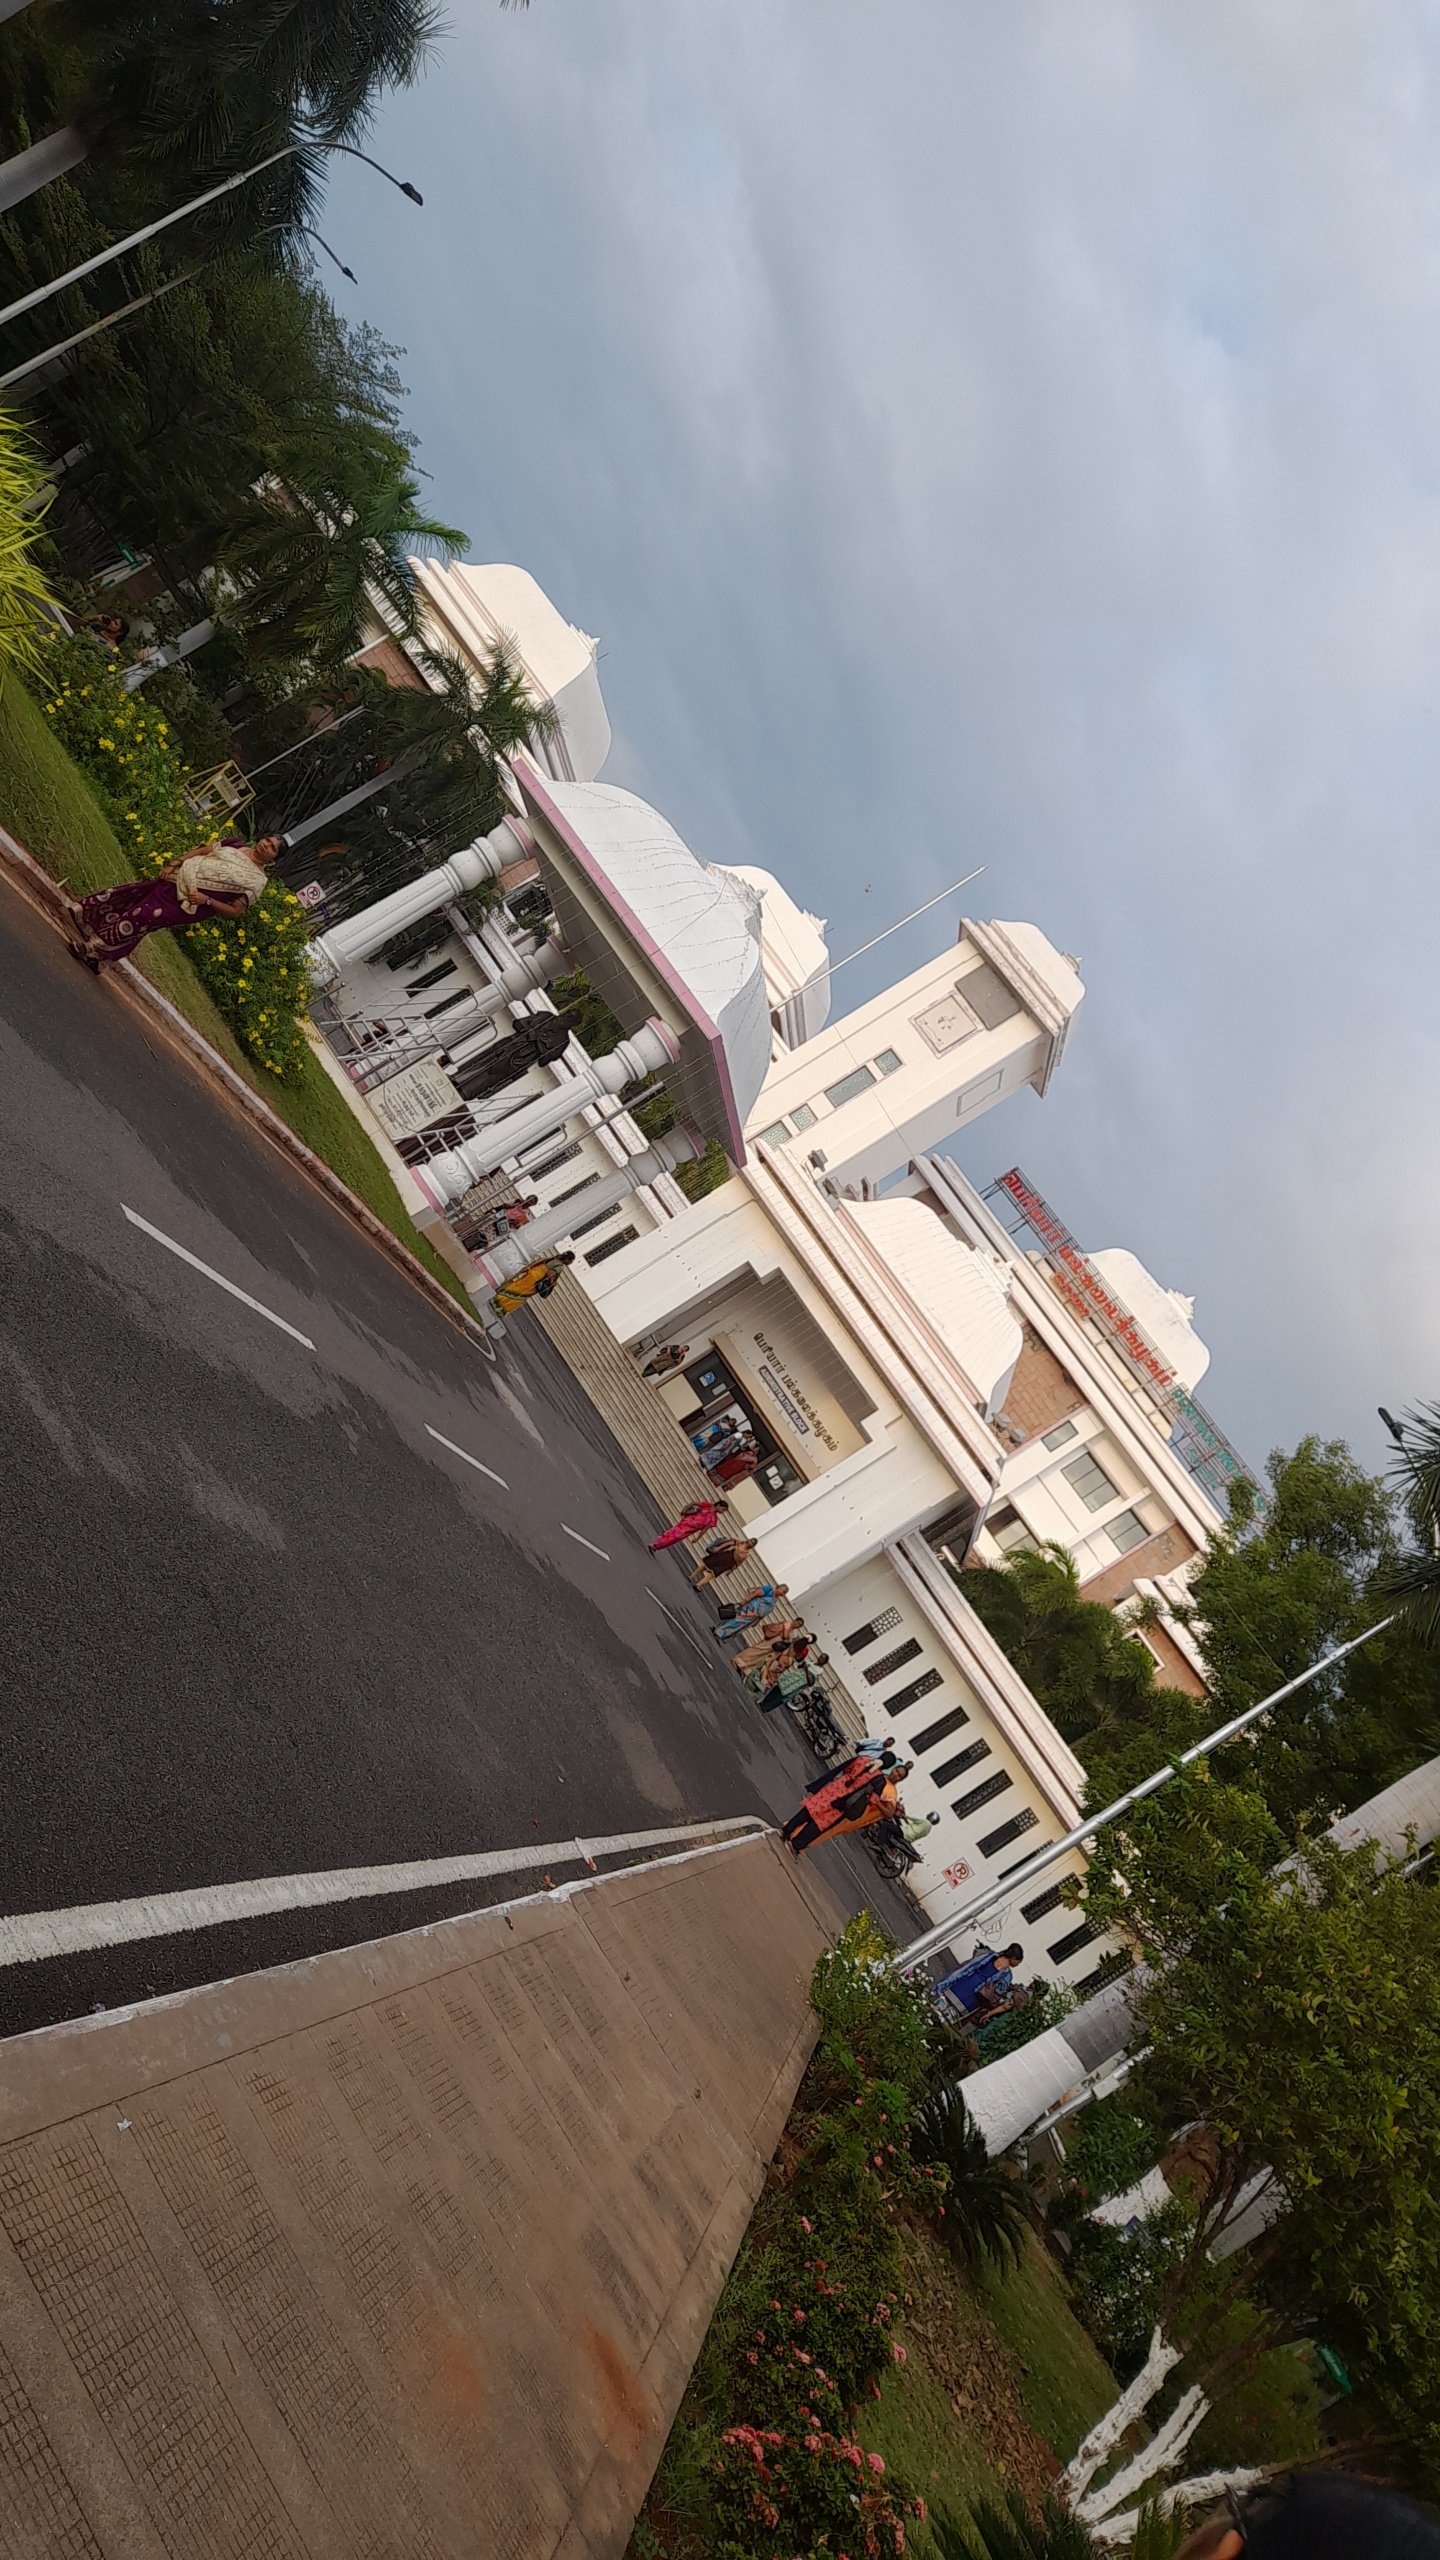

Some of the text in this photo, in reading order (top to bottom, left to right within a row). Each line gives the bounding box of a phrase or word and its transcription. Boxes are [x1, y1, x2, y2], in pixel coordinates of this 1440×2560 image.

[753, 1332, 839, 1451] பெரியார் பல்கலைக்கழகம்
[760, 1368, 808, 1433] ADMINISTRATIVE BLOCK
